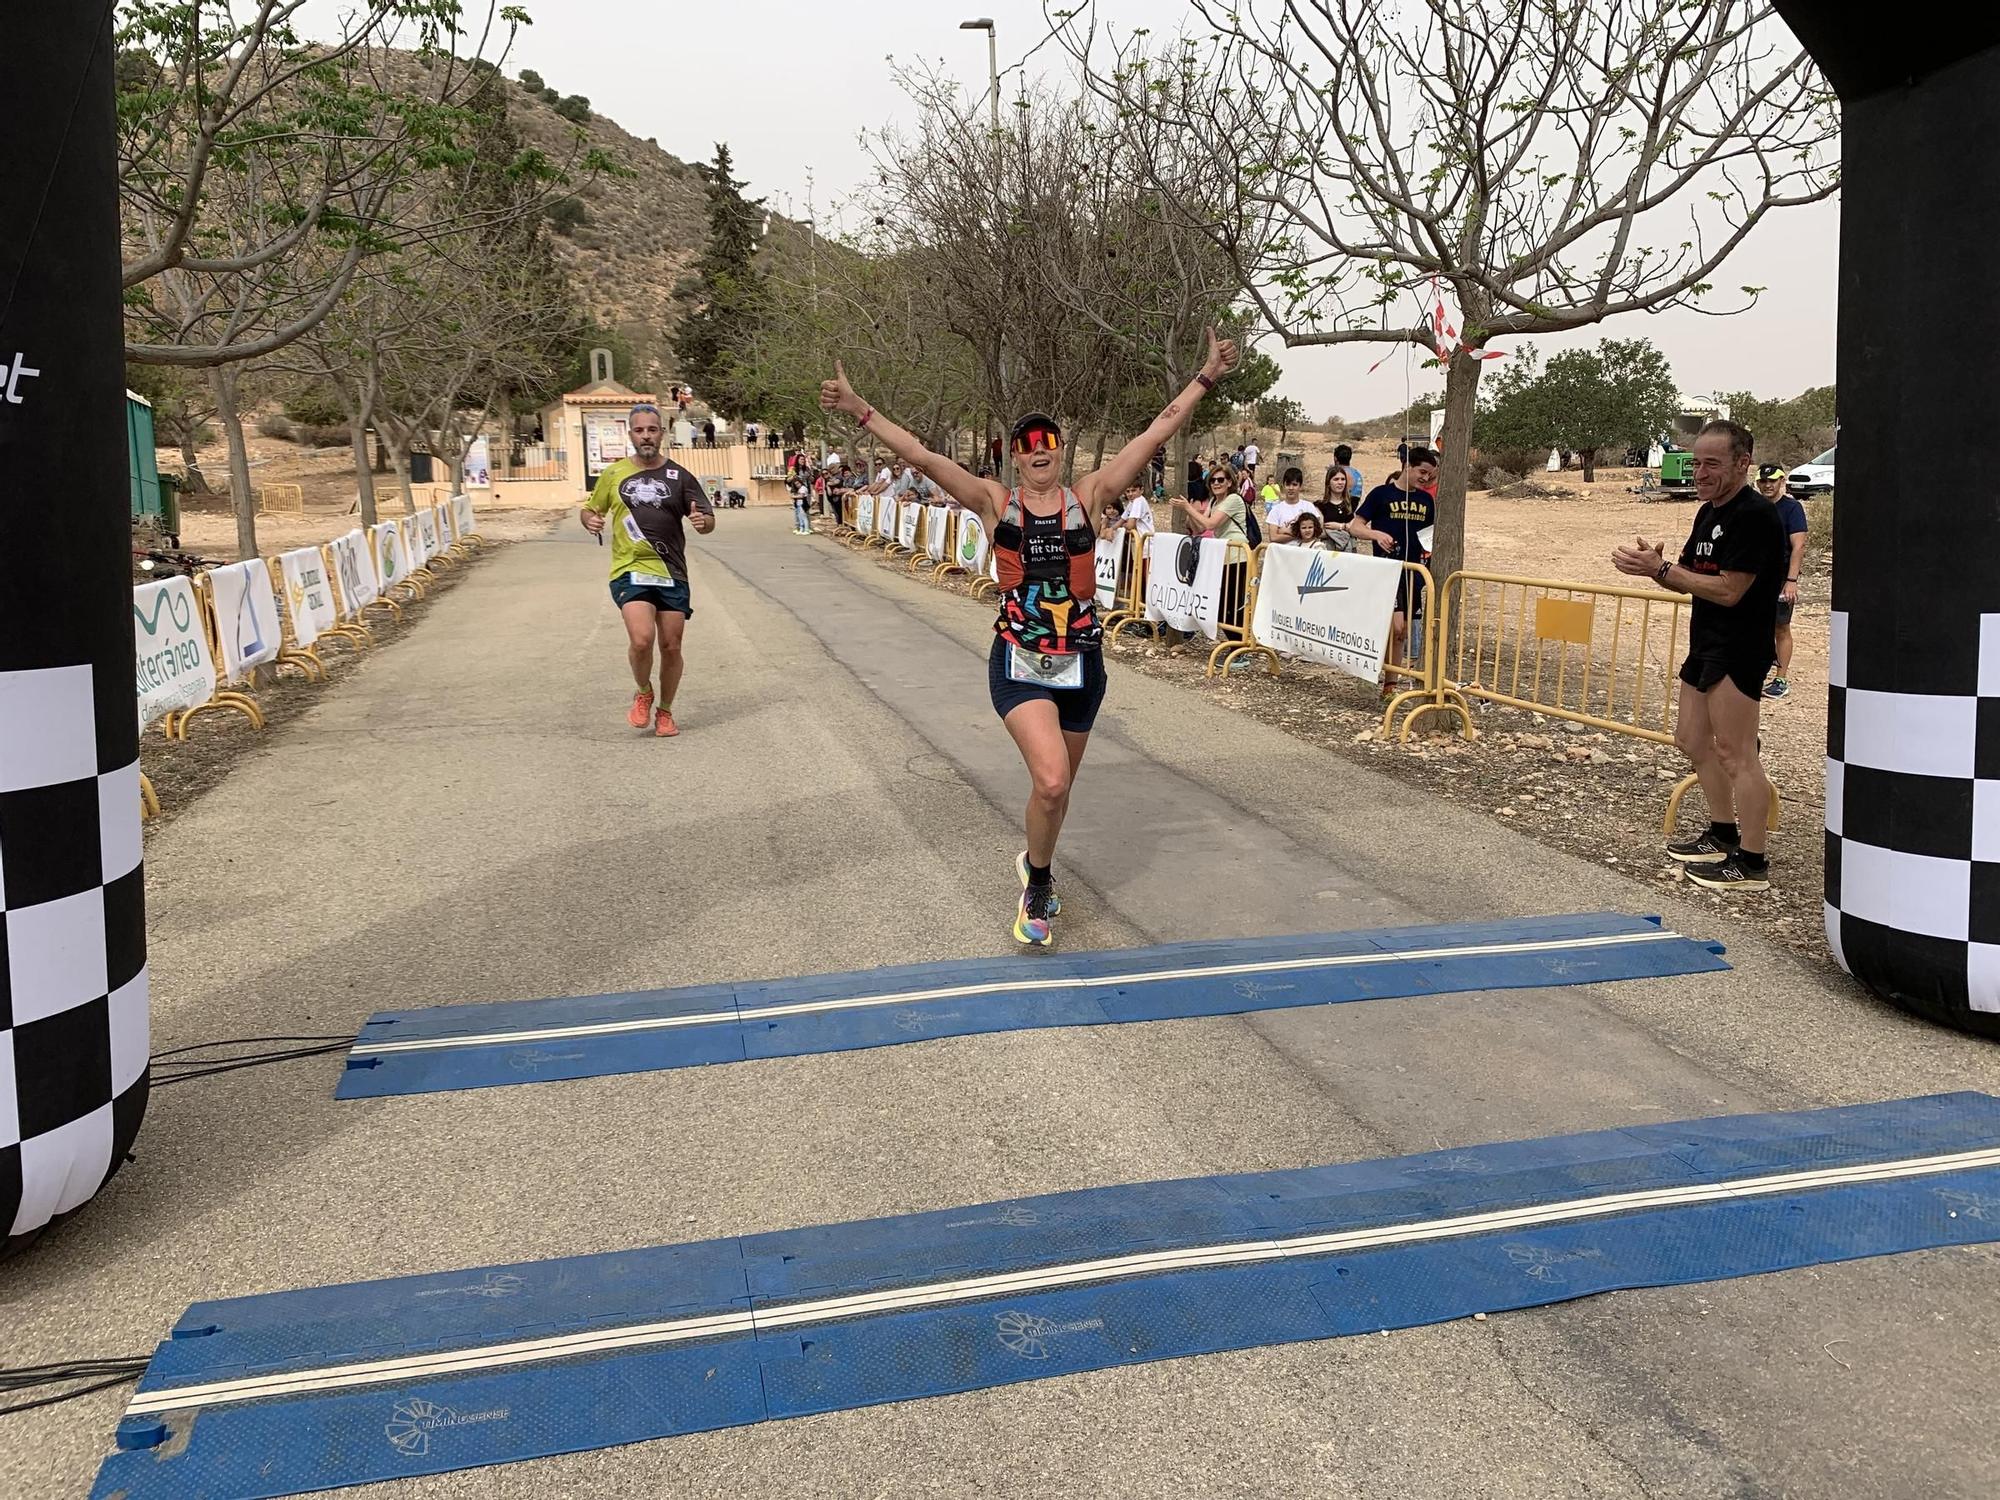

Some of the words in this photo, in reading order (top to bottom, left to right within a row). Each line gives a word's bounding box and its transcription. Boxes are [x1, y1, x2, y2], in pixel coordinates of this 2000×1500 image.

[1389, 501, 1427, 514] UCAM
[1271, 608, 1293, 628] MIGUEL
[1295, 616, 1326, 638] MORENO
[1327, 625, 1363, 648] MEROÑO
[1363, 638, 1379, 654] S.L.
[1040, 655, 1053, 670] 6
[1270, 630, 1313, 652] SANIDAD
[1321, 647, 1377, 672] VEGETAL
